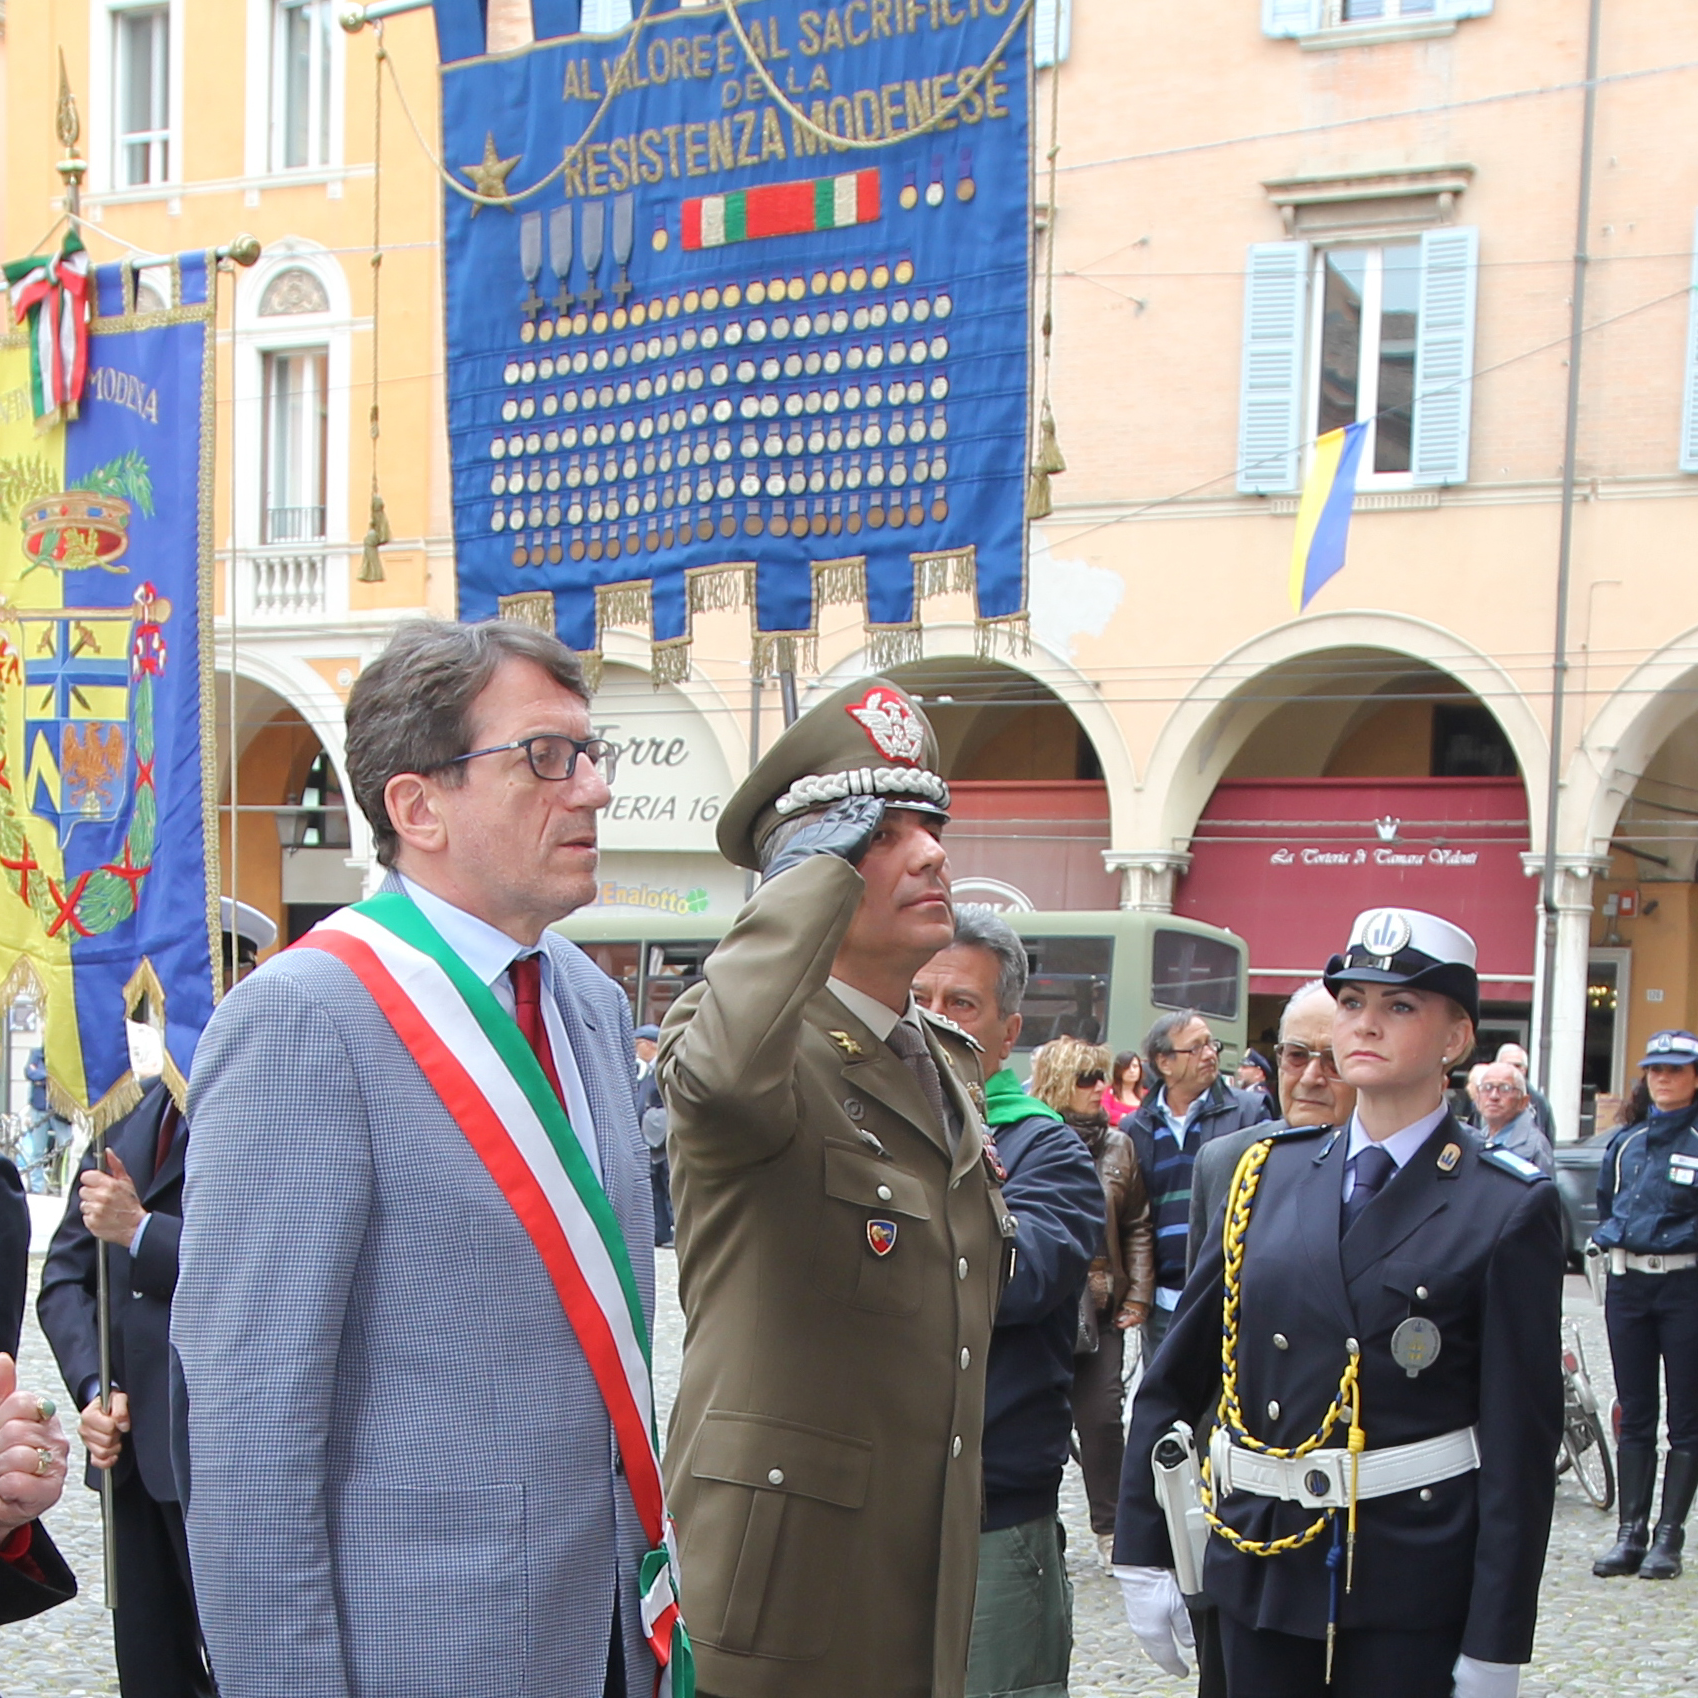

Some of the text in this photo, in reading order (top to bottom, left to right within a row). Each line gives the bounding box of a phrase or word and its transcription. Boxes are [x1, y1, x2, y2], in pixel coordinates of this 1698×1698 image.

[562, 58, 602, 102] AL
[602, 34, 713, 95] VALORE
[717, 29, 735, 73] E
[745, 16, 790, 64] AL
[563, 60, 1009, 198] RESISTENZA MODENESE
[89, 366, 159, 425] MODENA
[688, 796, 720, 822] 16
